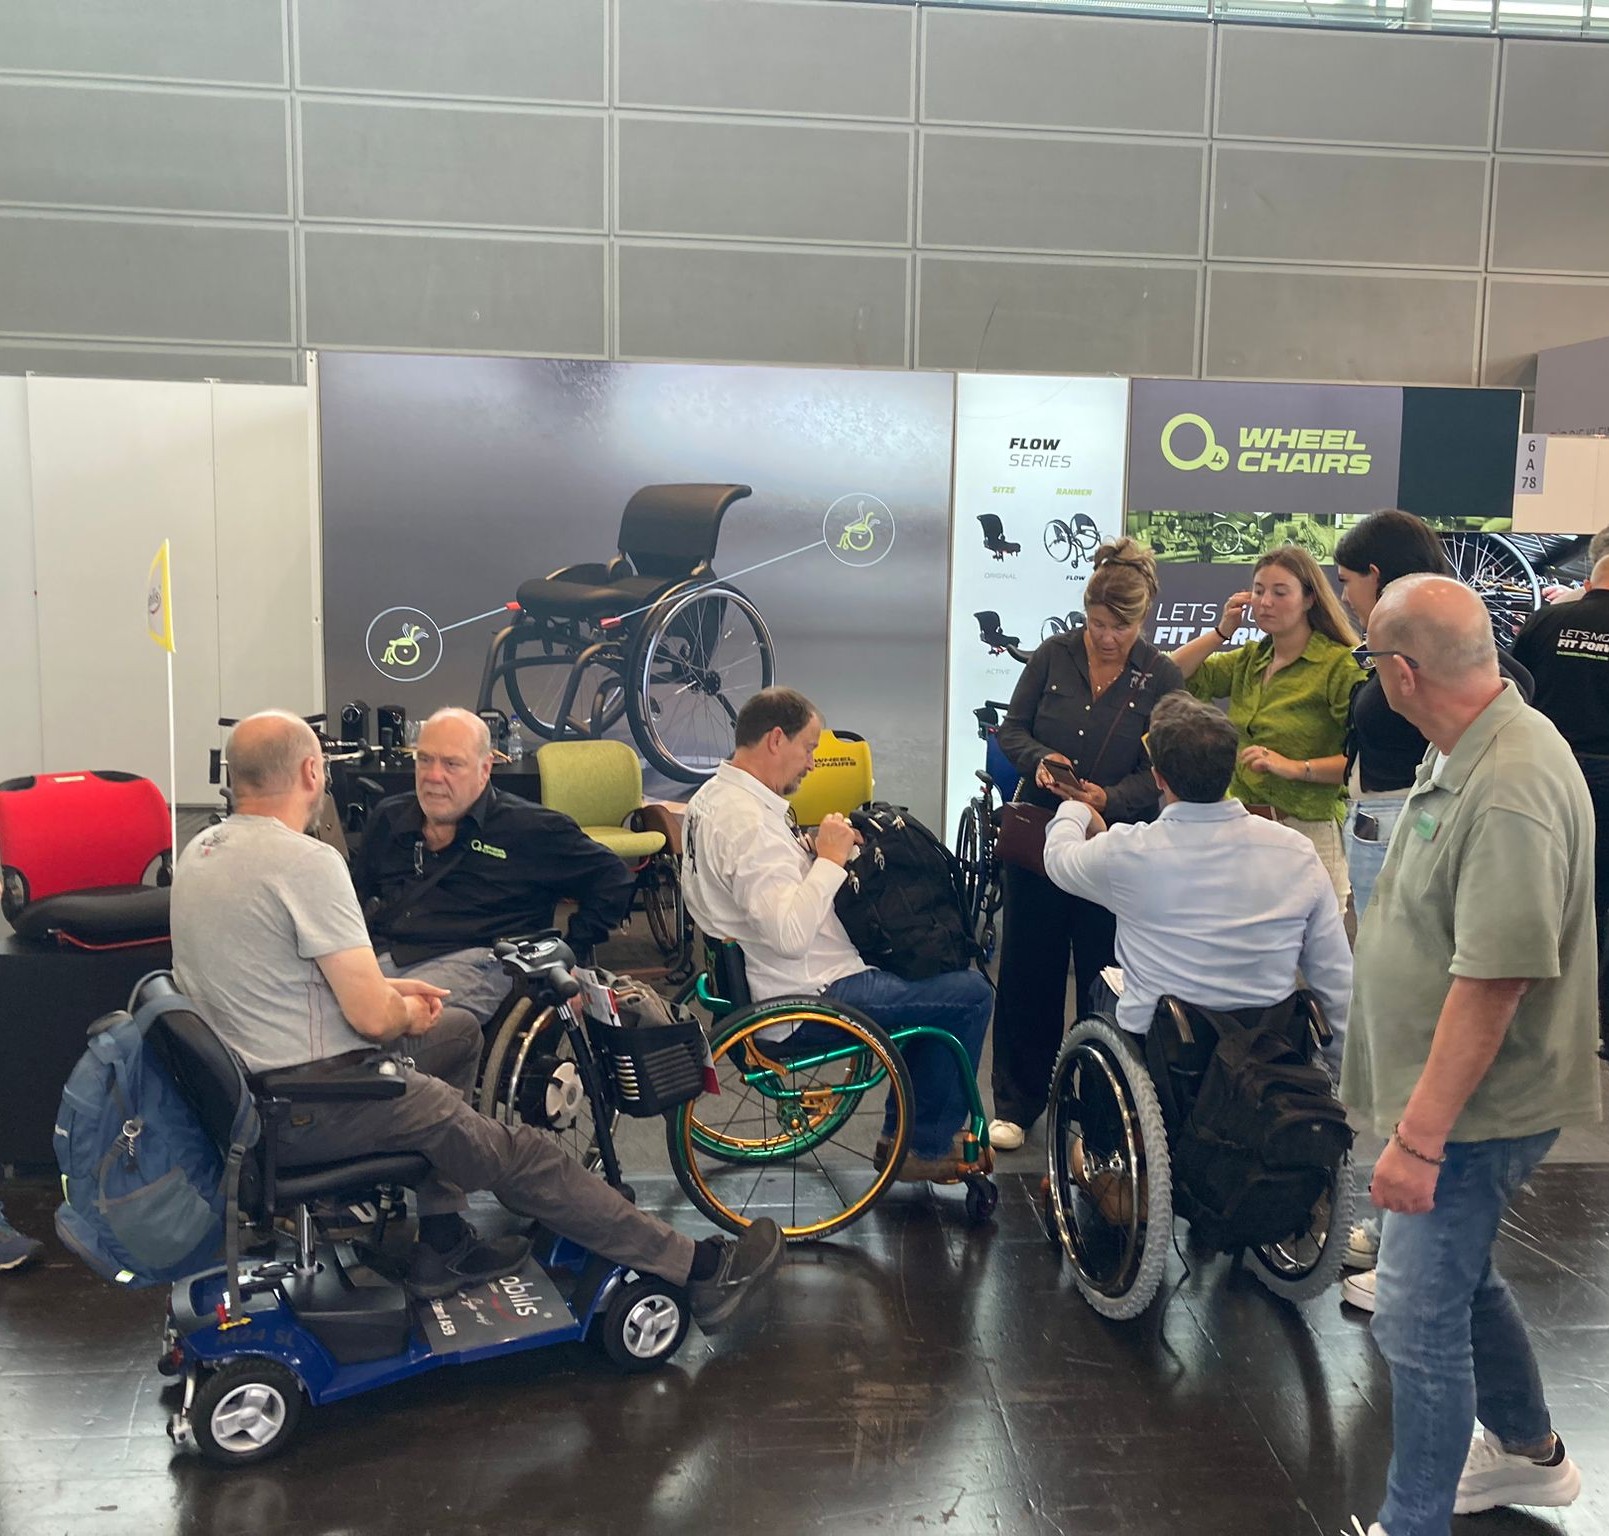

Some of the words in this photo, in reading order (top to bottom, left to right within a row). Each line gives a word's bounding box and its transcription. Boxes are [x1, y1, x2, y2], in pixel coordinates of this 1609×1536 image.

[1009, 438, 1061, 450] FLOW
[1239, 427, 1366, 450] WHEEL
[1528, 440, 1536, 452] 6
[1009, 454, 1072, 468] SERIES
[1237, 452, 1372, 475] CHAIRS
[1525, 458, 1535, 471] A
[1521, 476, 1537, 489] 78
[992, 486, 1016, 494] SITZE
[1156, 603, 1218, 622] LETS
[1153, 626, 1195, 645] FIT
[1557, 638, 1579, 648] FIT
[499, 1276, 542, 1317] obilis
